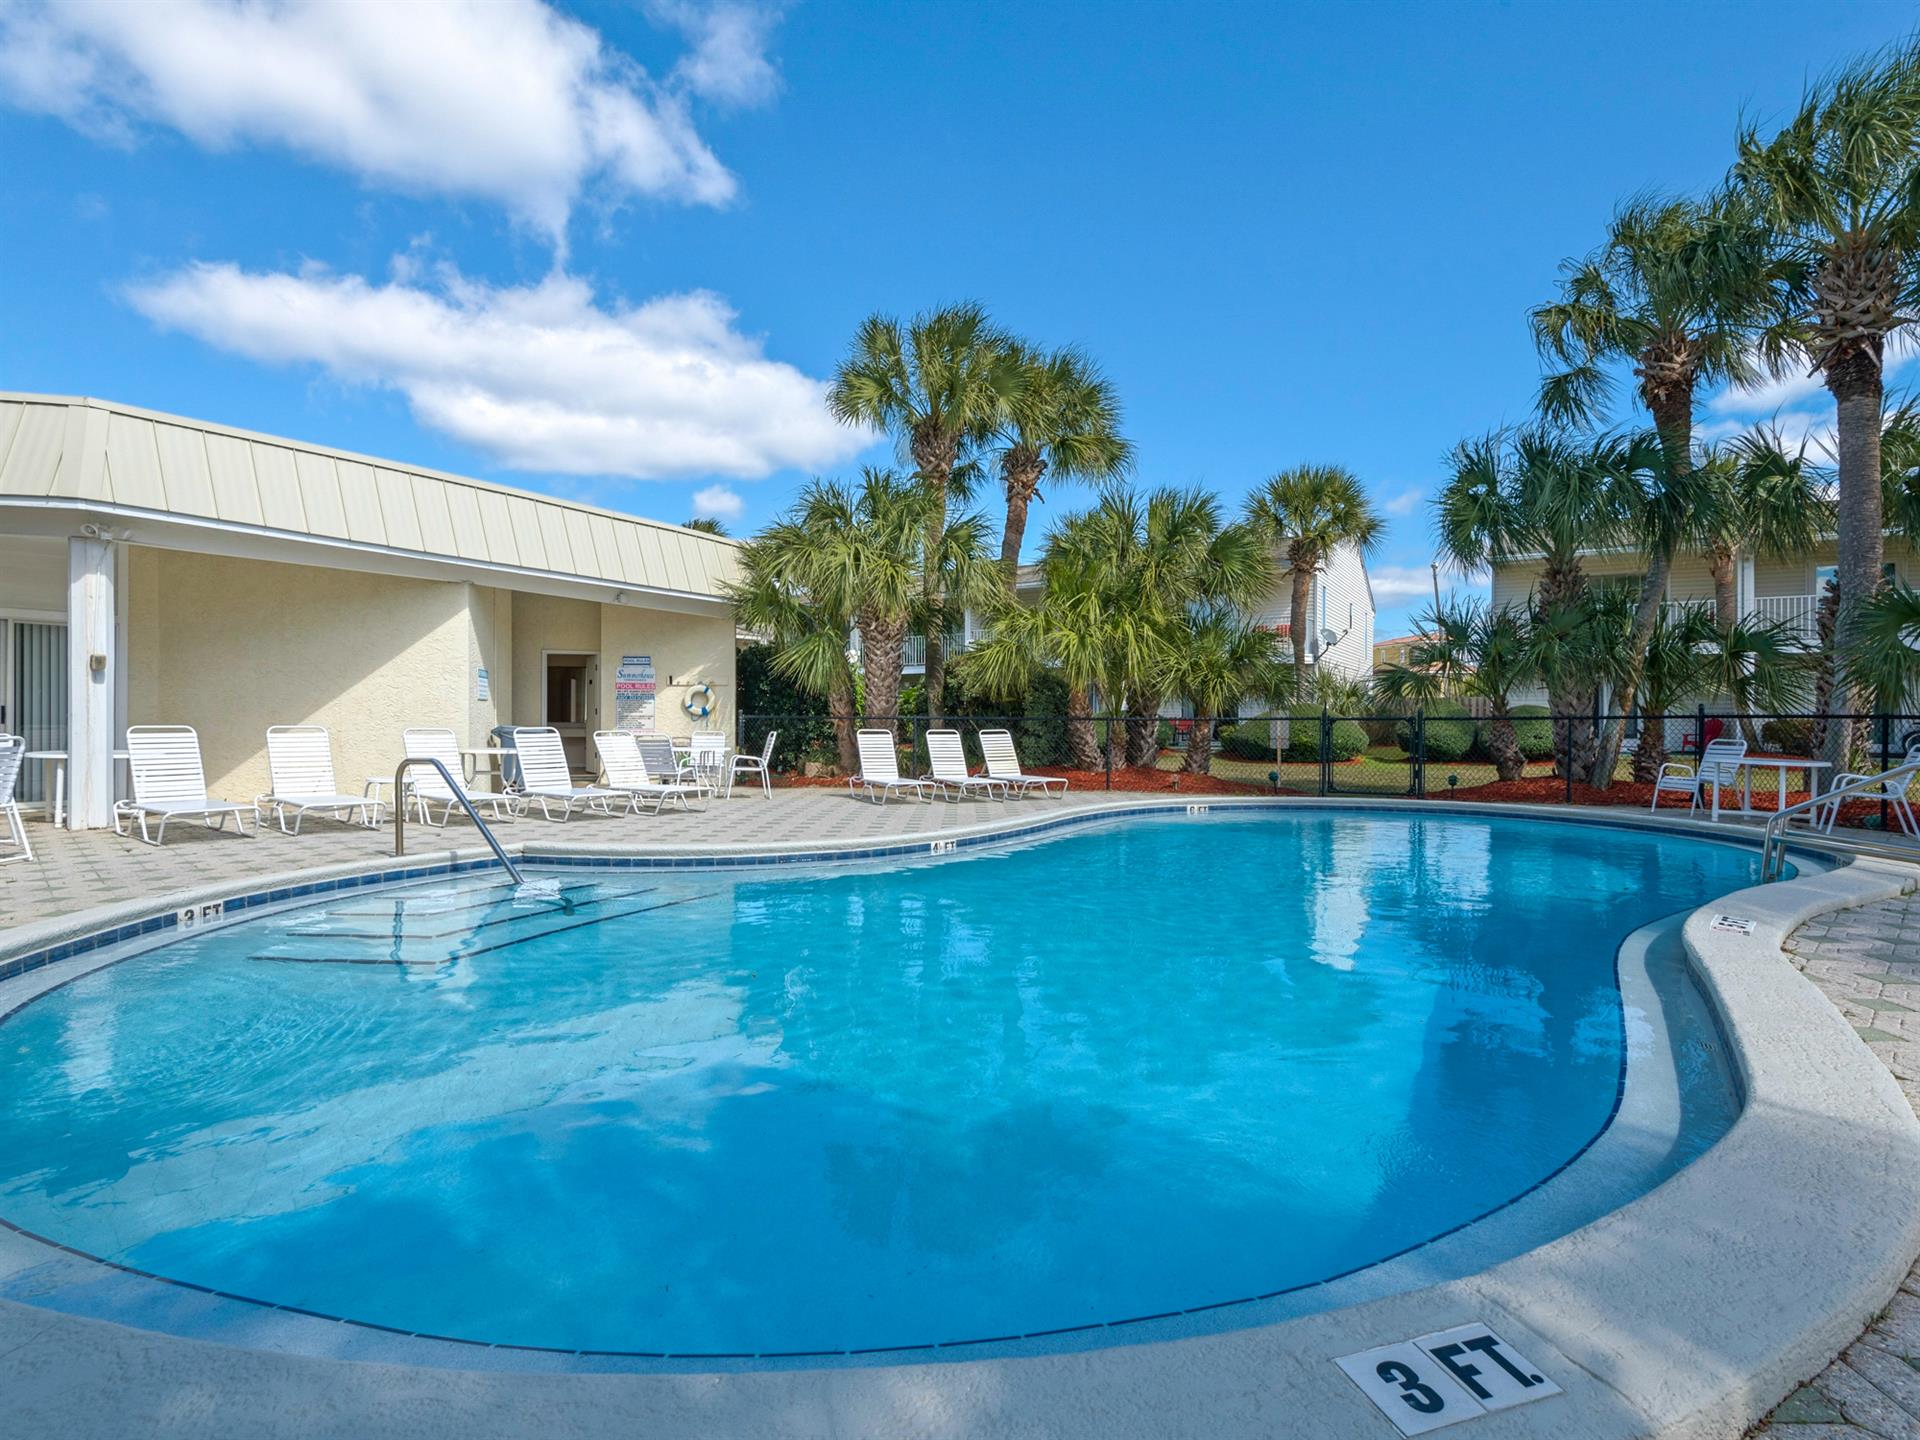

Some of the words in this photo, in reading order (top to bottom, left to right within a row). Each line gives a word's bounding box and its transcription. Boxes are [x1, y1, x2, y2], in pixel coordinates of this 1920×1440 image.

[203, 903, 221, 918] FT
[1376, 1360, 1445, 1414] 3
[1428, 1334, 1545, 1400] FT.
